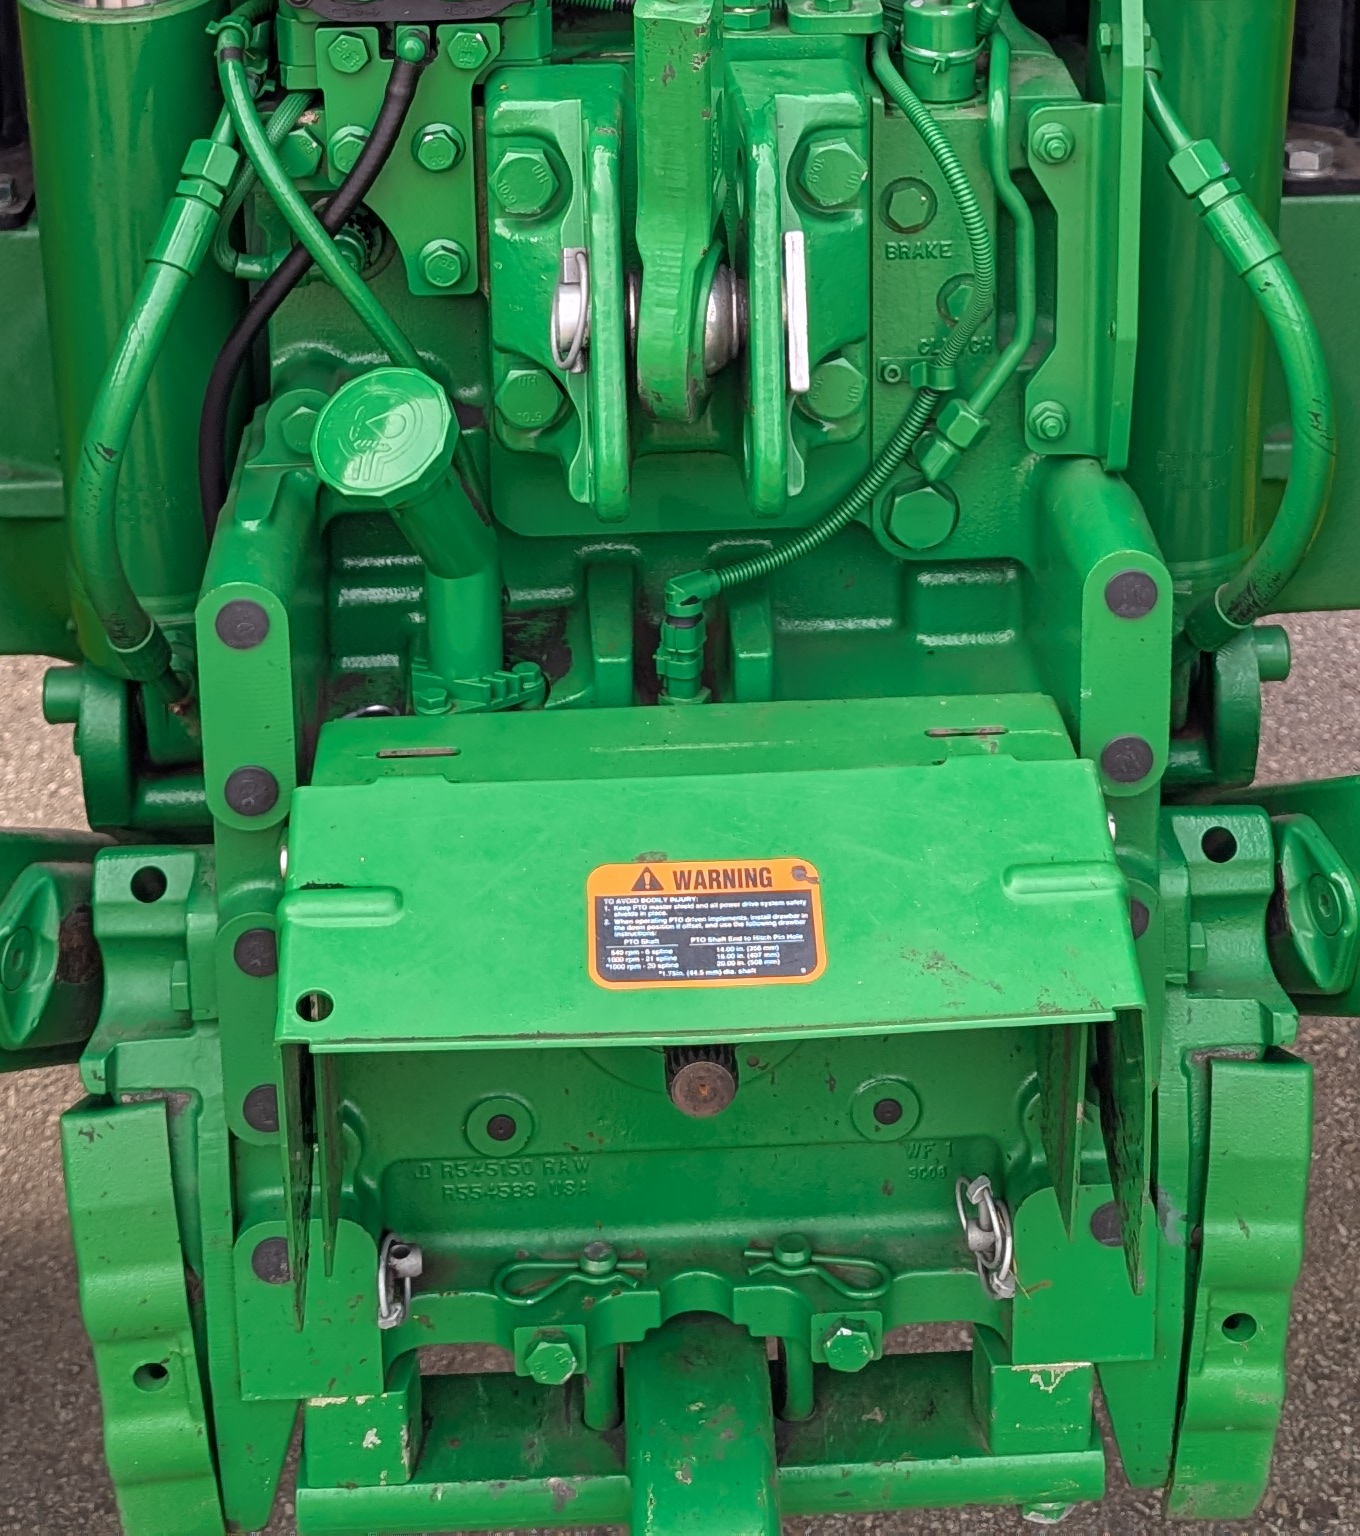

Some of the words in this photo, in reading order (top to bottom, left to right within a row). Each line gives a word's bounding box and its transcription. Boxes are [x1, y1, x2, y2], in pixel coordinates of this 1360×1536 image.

[885, 240, 953, 260] BRAKE
[918, 336, 992, 355] CLCH
[672, 867, 773, 891] WARNING
[785, 899, 807, 907] safety
[543, 1156, 591, 1175] RAW
[547, 1179, 591, 1197] USA
